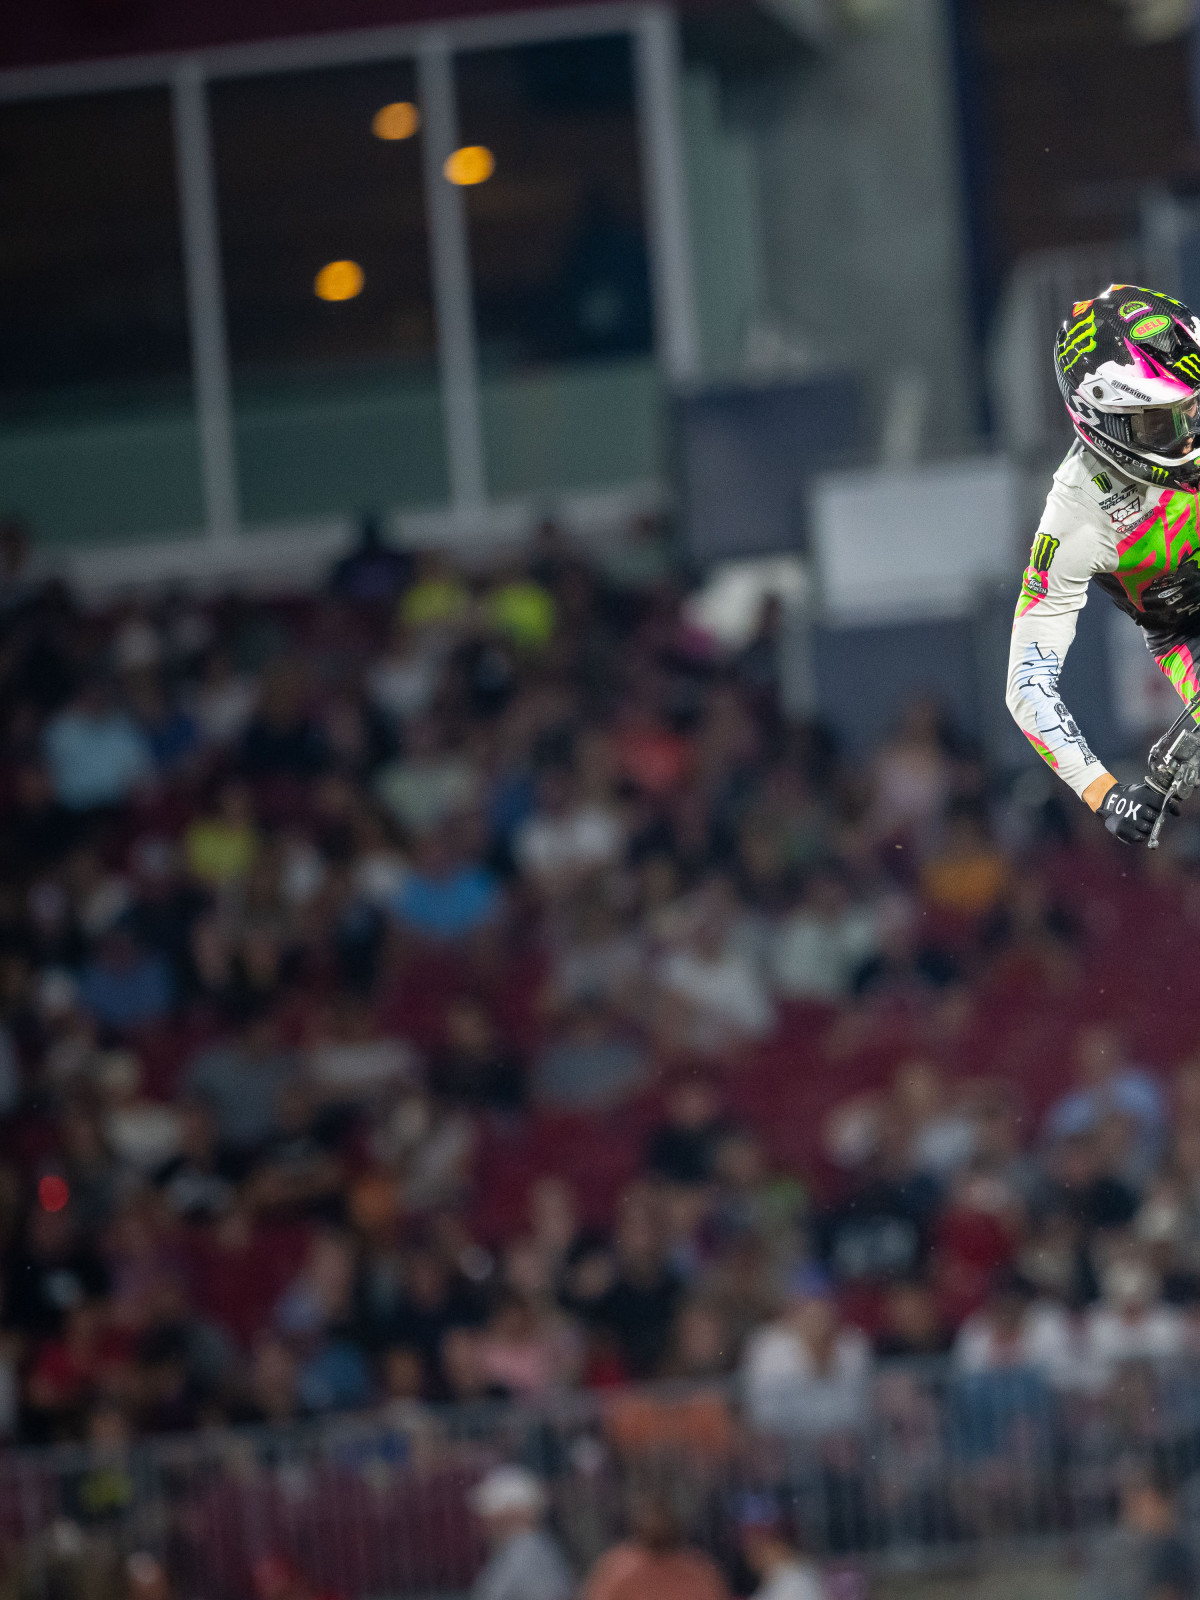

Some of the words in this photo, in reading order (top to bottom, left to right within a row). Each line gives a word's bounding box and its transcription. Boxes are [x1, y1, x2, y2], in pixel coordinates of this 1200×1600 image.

[1135, 318, 1165, 336] BELL
[1088, 432, 1149, 472] MONSTER
[1106, 793, 1142, 821] FOX
